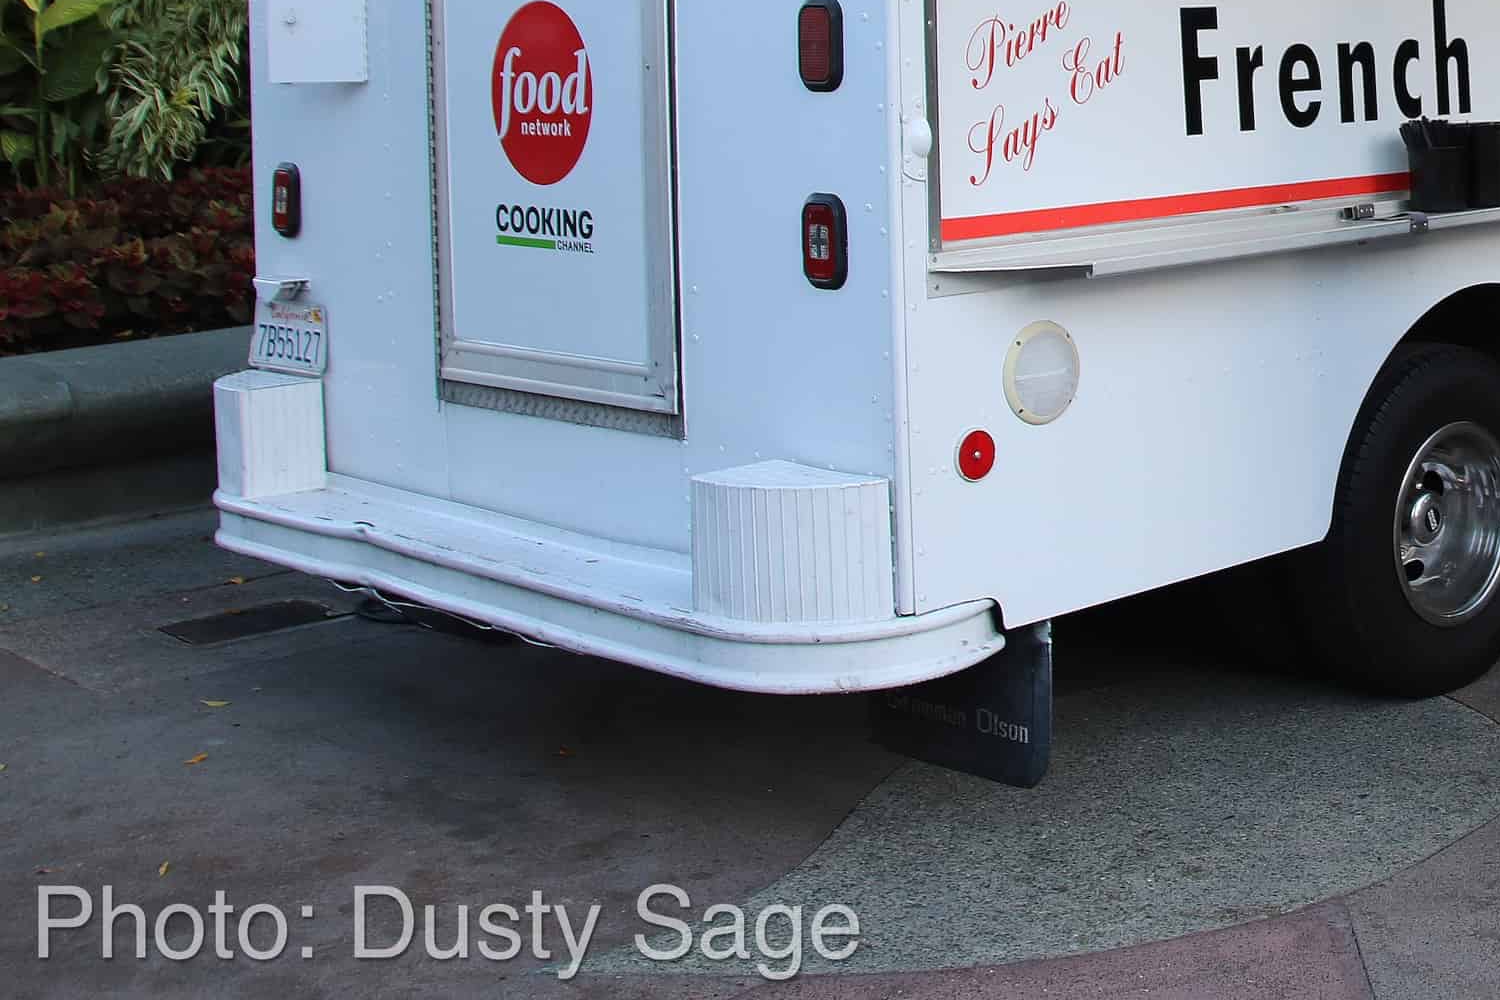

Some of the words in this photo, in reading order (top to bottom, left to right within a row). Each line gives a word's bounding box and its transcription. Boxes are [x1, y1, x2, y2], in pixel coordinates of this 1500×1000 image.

[966, 0, 1071, 90] Pierre
[498, 46, 589, 141] food
[967, 96, 1059, 186] Says
[1062, 31, 1126, 104] Eat
[520, 118, 572, 137] network
[496, 203, 594, 239] COOKING
[557, 239, 595, 254] CHANNEL
[976, 707, 1030, 744] Olson
